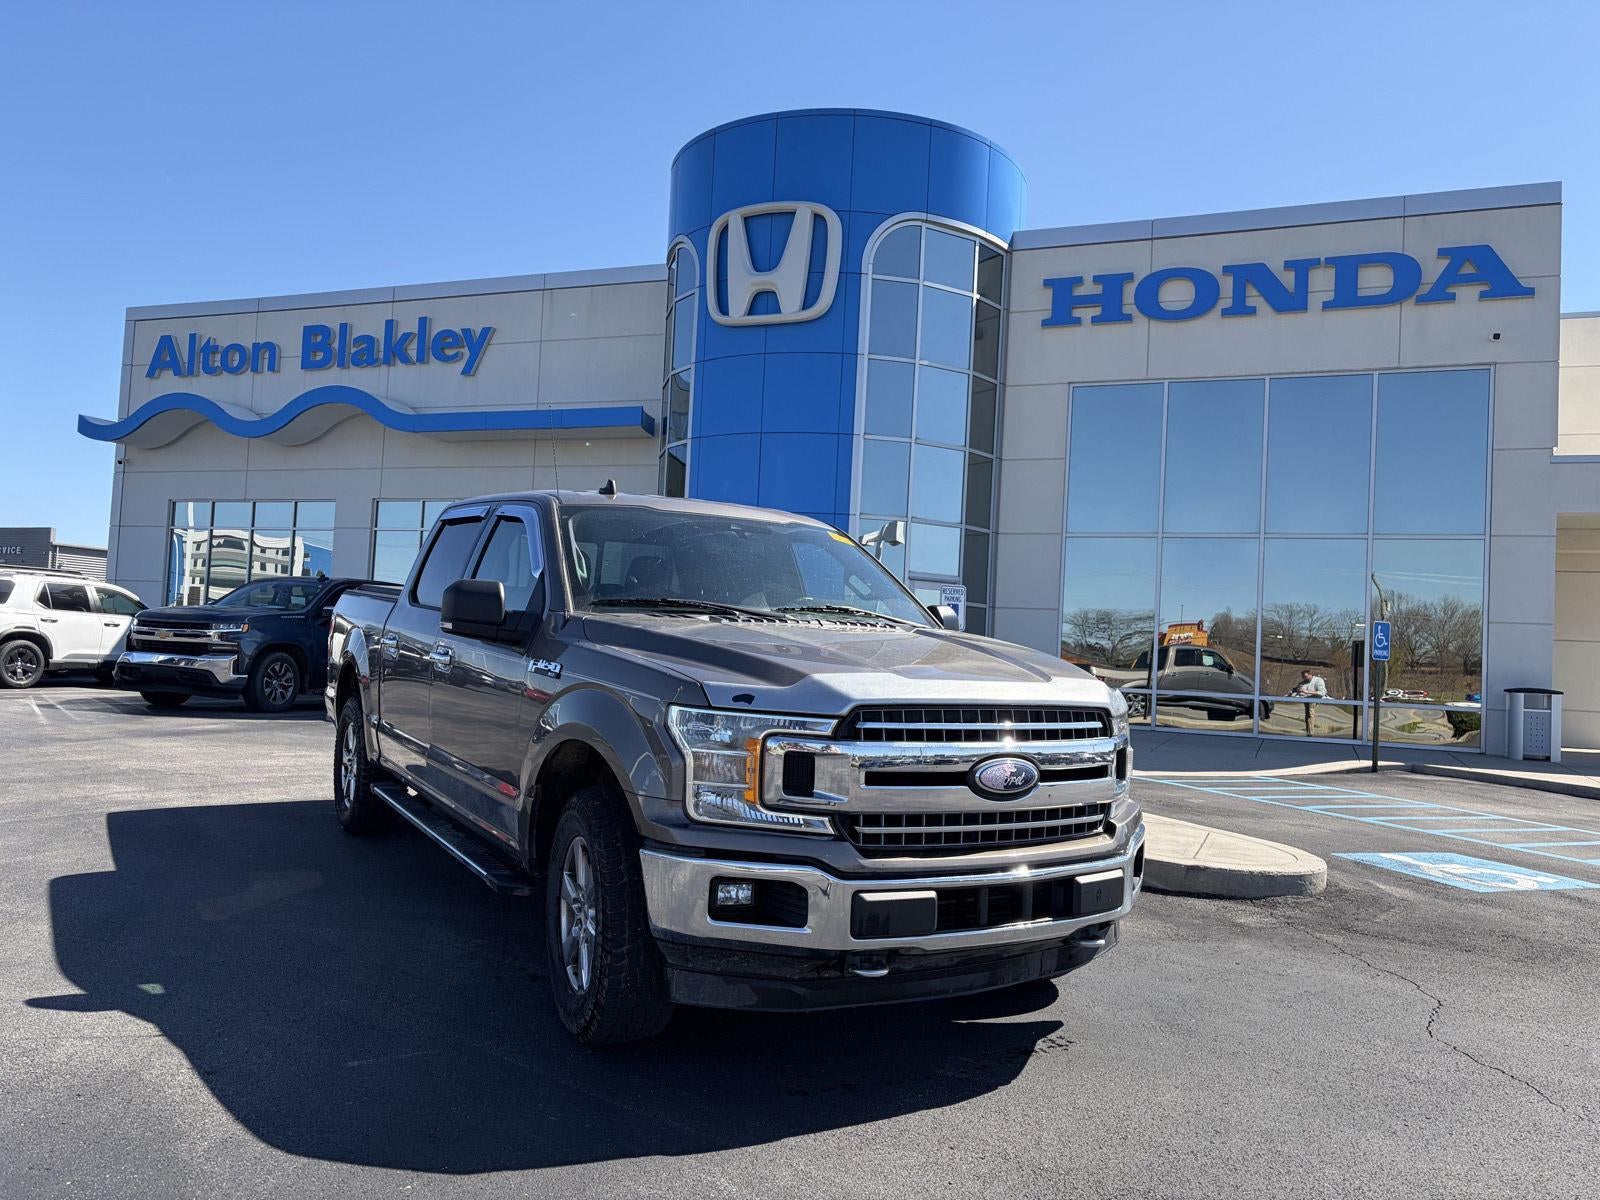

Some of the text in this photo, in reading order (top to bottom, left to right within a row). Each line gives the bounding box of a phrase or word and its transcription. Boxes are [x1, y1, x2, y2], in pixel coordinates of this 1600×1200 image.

[1040, 244, 1536, 328] HONDA
[145, 315, 495, 379] Alton Blakley
[1373, 649, 1389, 657] PARKING
